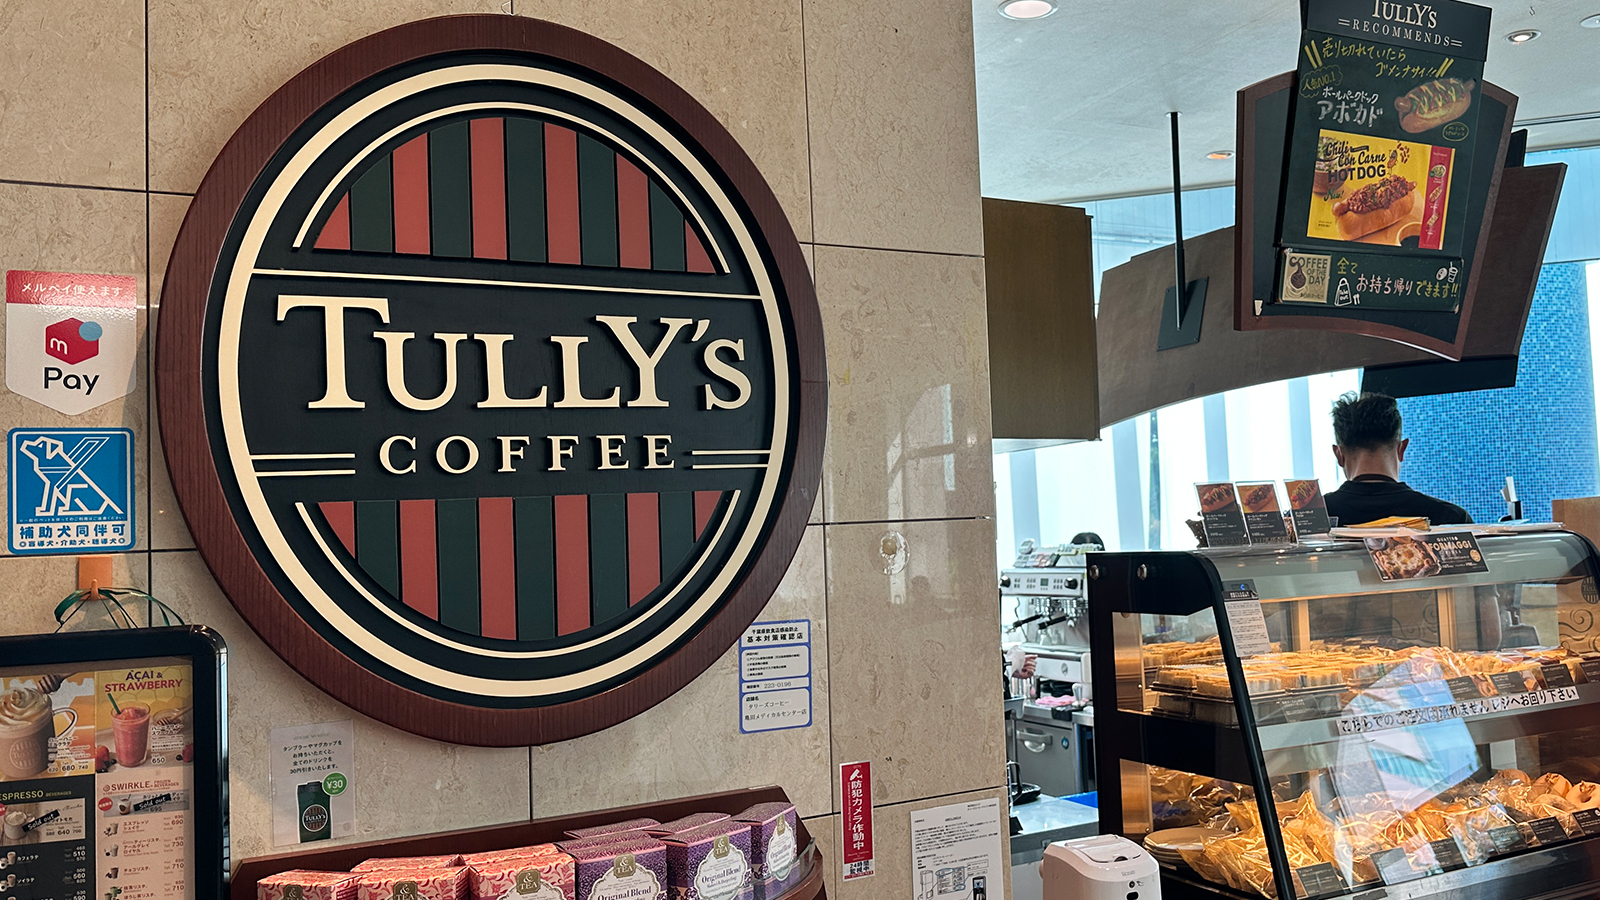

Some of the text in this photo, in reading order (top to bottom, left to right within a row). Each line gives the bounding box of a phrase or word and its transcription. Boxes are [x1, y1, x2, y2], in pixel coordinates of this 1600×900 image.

[1352, 19, 1450, 47] RECOMMENDS
[1322, 37, 1407, 62] 売り切れていたら
[1317, 100, 1384, 127] アボカド
[1325, 141, 1349, 157] Chili
[1358, 151, 1386, 165] Carne
[1328, 164, 1386, 183] HOT DOG
[1289, 256, 1328, 269] COFFEE
[1337, 257, 1358, 274] 全て
[1307, 268, 1315, 276] OF
[1308, 276, 1326, 286] DAY
[22, 283, 123, 297] メルペイ使えます
[43, 366, 100, 396] Pay
[379, 434, 676, 475] COFFEE
[20, 523, 126, 540] 補助犬同伴可
[1427, 540, 1473, 551] FORMAGGI
[105, 679, 183, 693] STRAWBERRY
[283, 740, 342, 752] タンブラーやマグカップを
[292, 756, 332, 766] 全てのドリンクを
[290, 764, 338, 774] 30円引きいたします。
[111, 780, 150, 791] SWIRKLE
[326, 779, 344, 790] ¥30
[0, 789, 44, 801] SPRESSO
[139, 801, 153, 809] Sold
[851, 780, 864, 850] 防犯カメラ作動中
[27, 819, 42, 830] Sold
[616, 865, 633, 874] TEA
[523, 872, 532, 883] &
[520, 881, 537, 890] TEA
[630, 885, 652, 896] Blend
